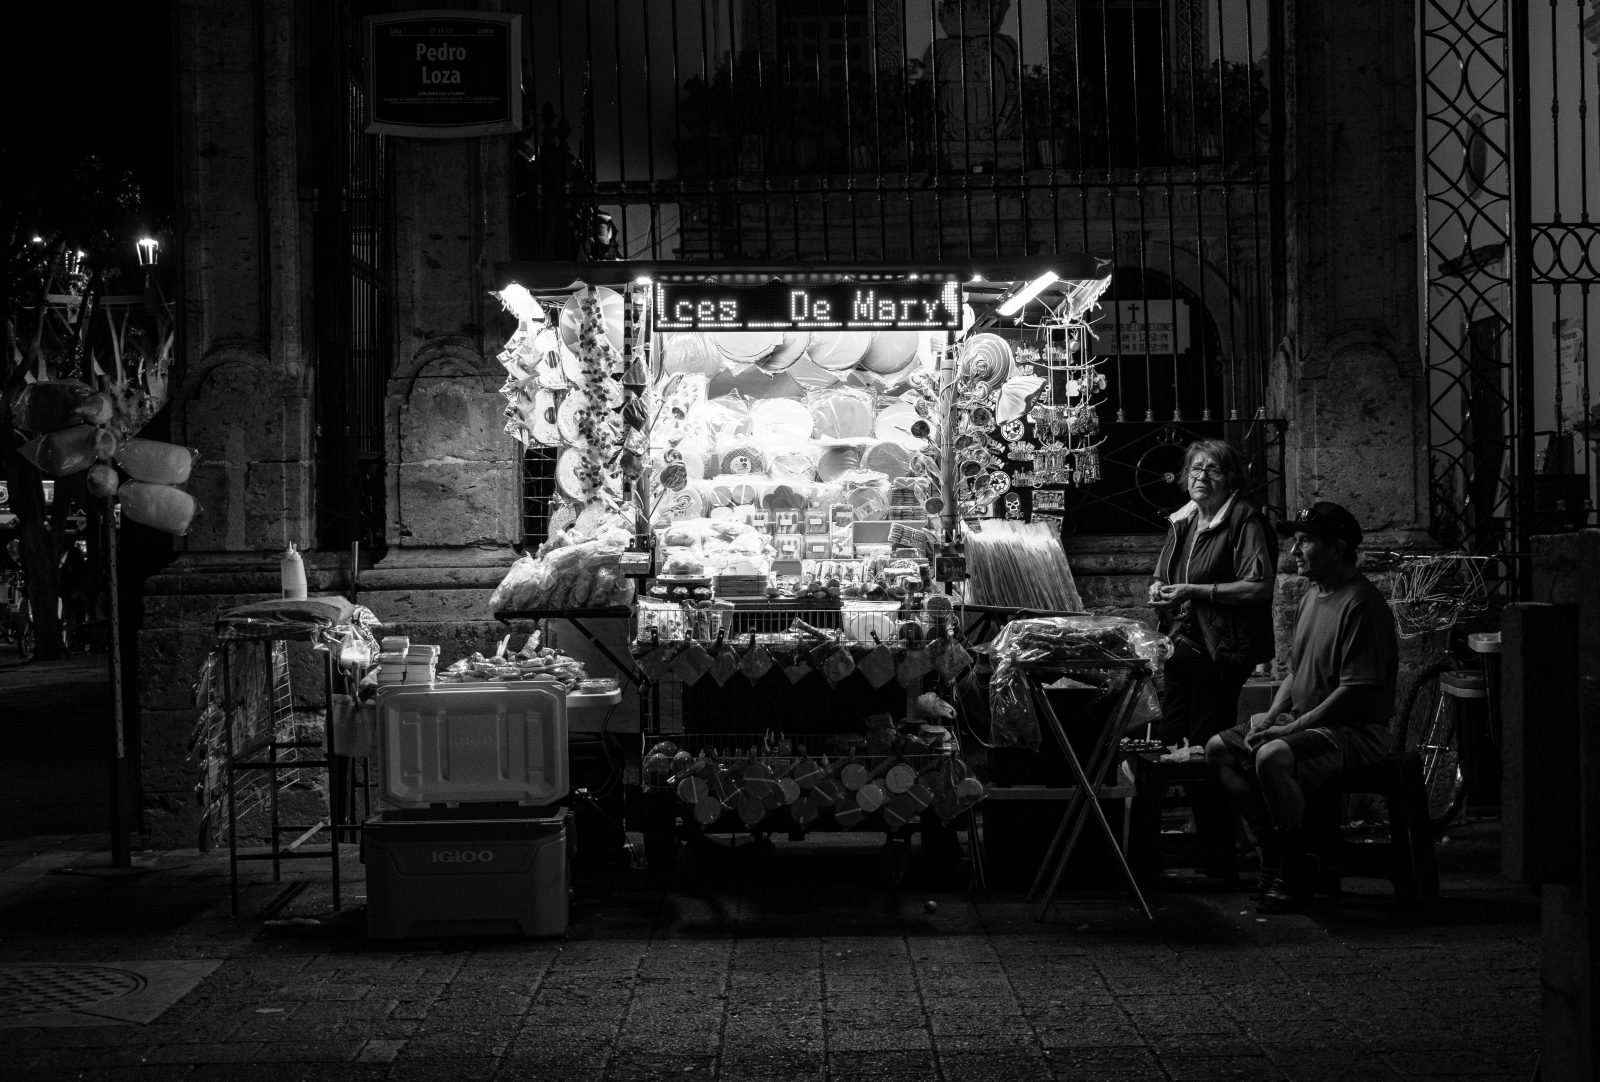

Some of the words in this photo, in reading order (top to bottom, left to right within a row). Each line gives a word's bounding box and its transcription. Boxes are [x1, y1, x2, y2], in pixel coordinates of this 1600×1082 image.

[416, 42, 467, 61] Pedro
[422, 65, 461, 84] Loza
[791, 290, 831, 321] De
[854, 289, 939, 324] Mary
[432, 850, 494, 864] IGLOO
